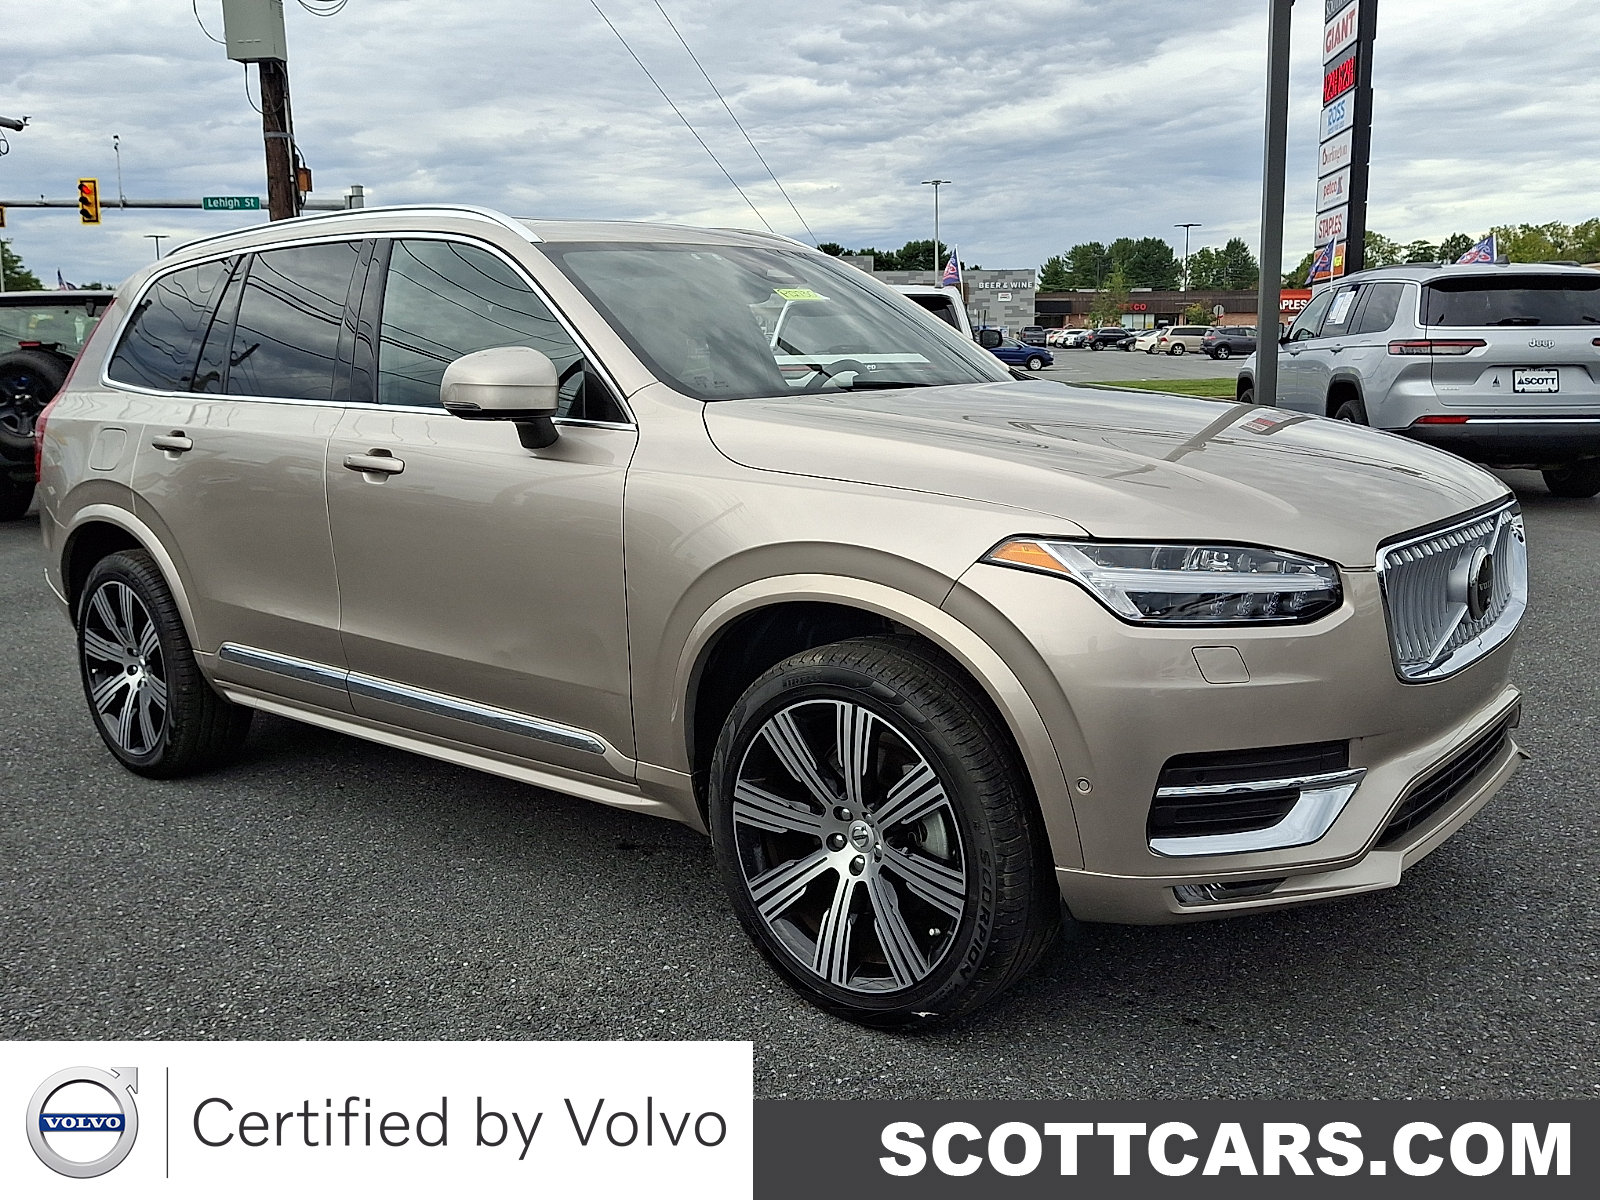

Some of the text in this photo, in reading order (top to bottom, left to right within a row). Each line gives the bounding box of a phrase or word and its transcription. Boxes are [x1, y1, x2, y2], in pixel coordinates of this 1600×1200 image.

[1325, 9, 1355, 53] GIANT
[1327, 100, 1345, 126] ROSS
[207, 198, 254, 209] Lehigh St
[1318, 213, 1342, 239] STAPLES
[1279, 299, 1308, 310] PLES
[1529, 338, 1555, 349] Jeep
[1524, 377, 1556, 385] SCOTT
[959, 848, 993, 981] SCORPION
